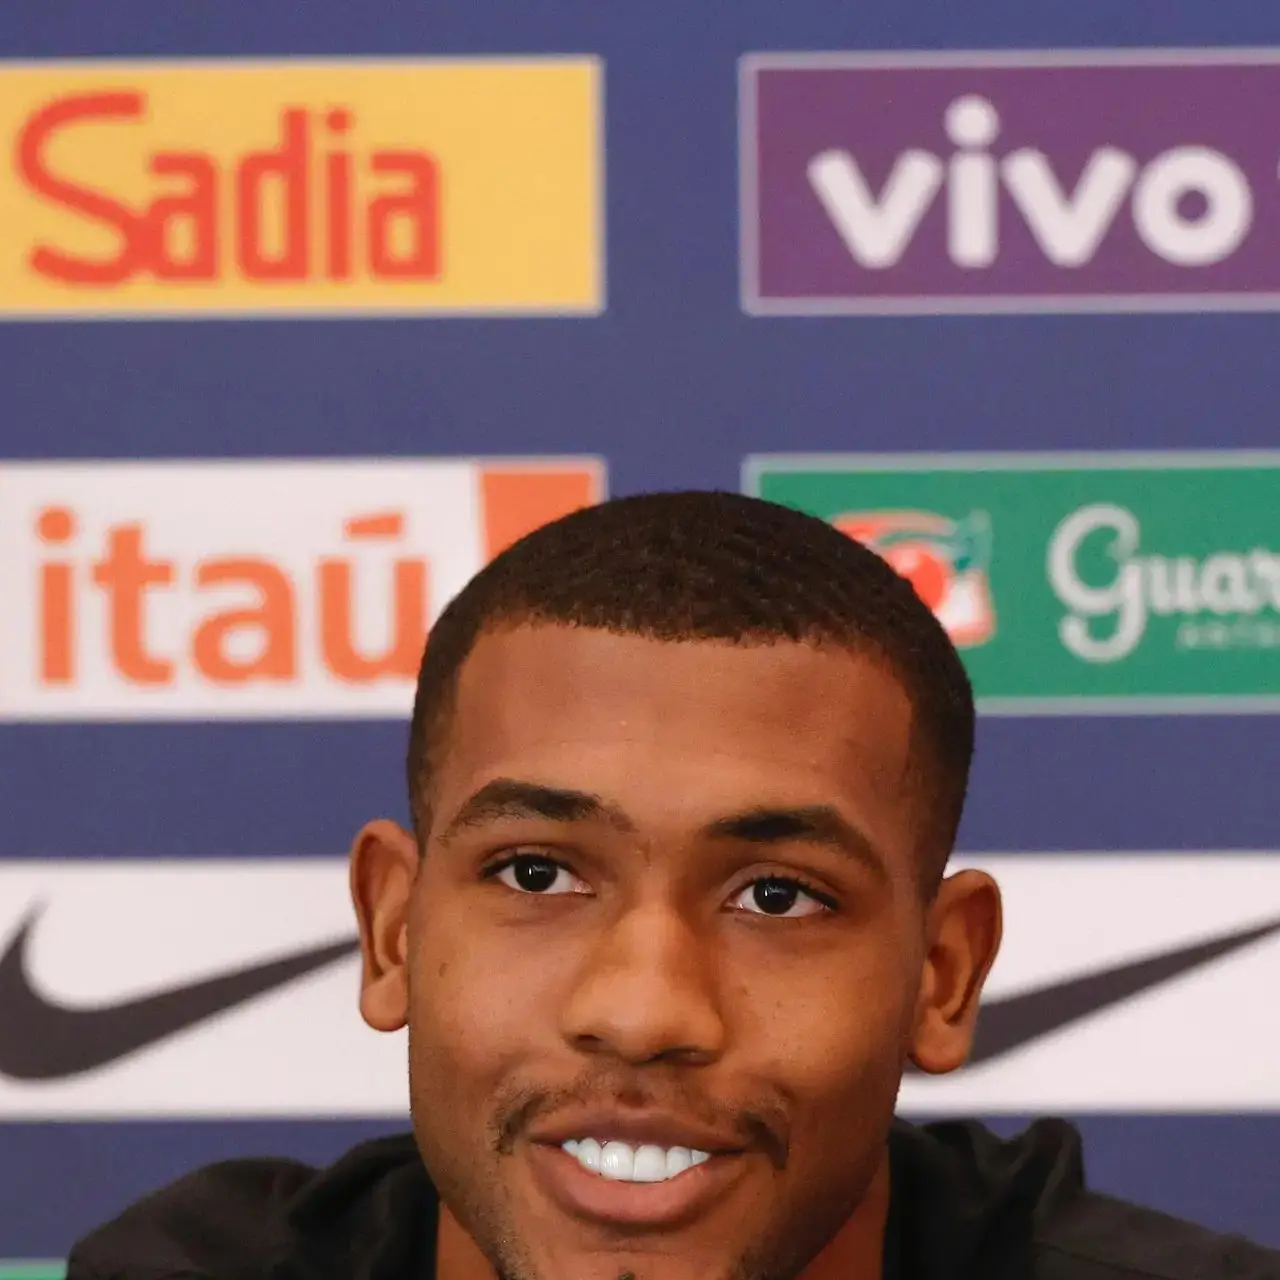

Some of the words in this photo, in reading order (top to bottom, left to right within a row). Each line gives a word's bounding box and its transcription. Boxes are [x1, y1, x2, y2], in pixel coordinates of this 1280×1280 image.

[12, 88, 443, 288] Sadia
[808, 95, 1253, 268] vivo
[34, 505, 432, 690] itaú
